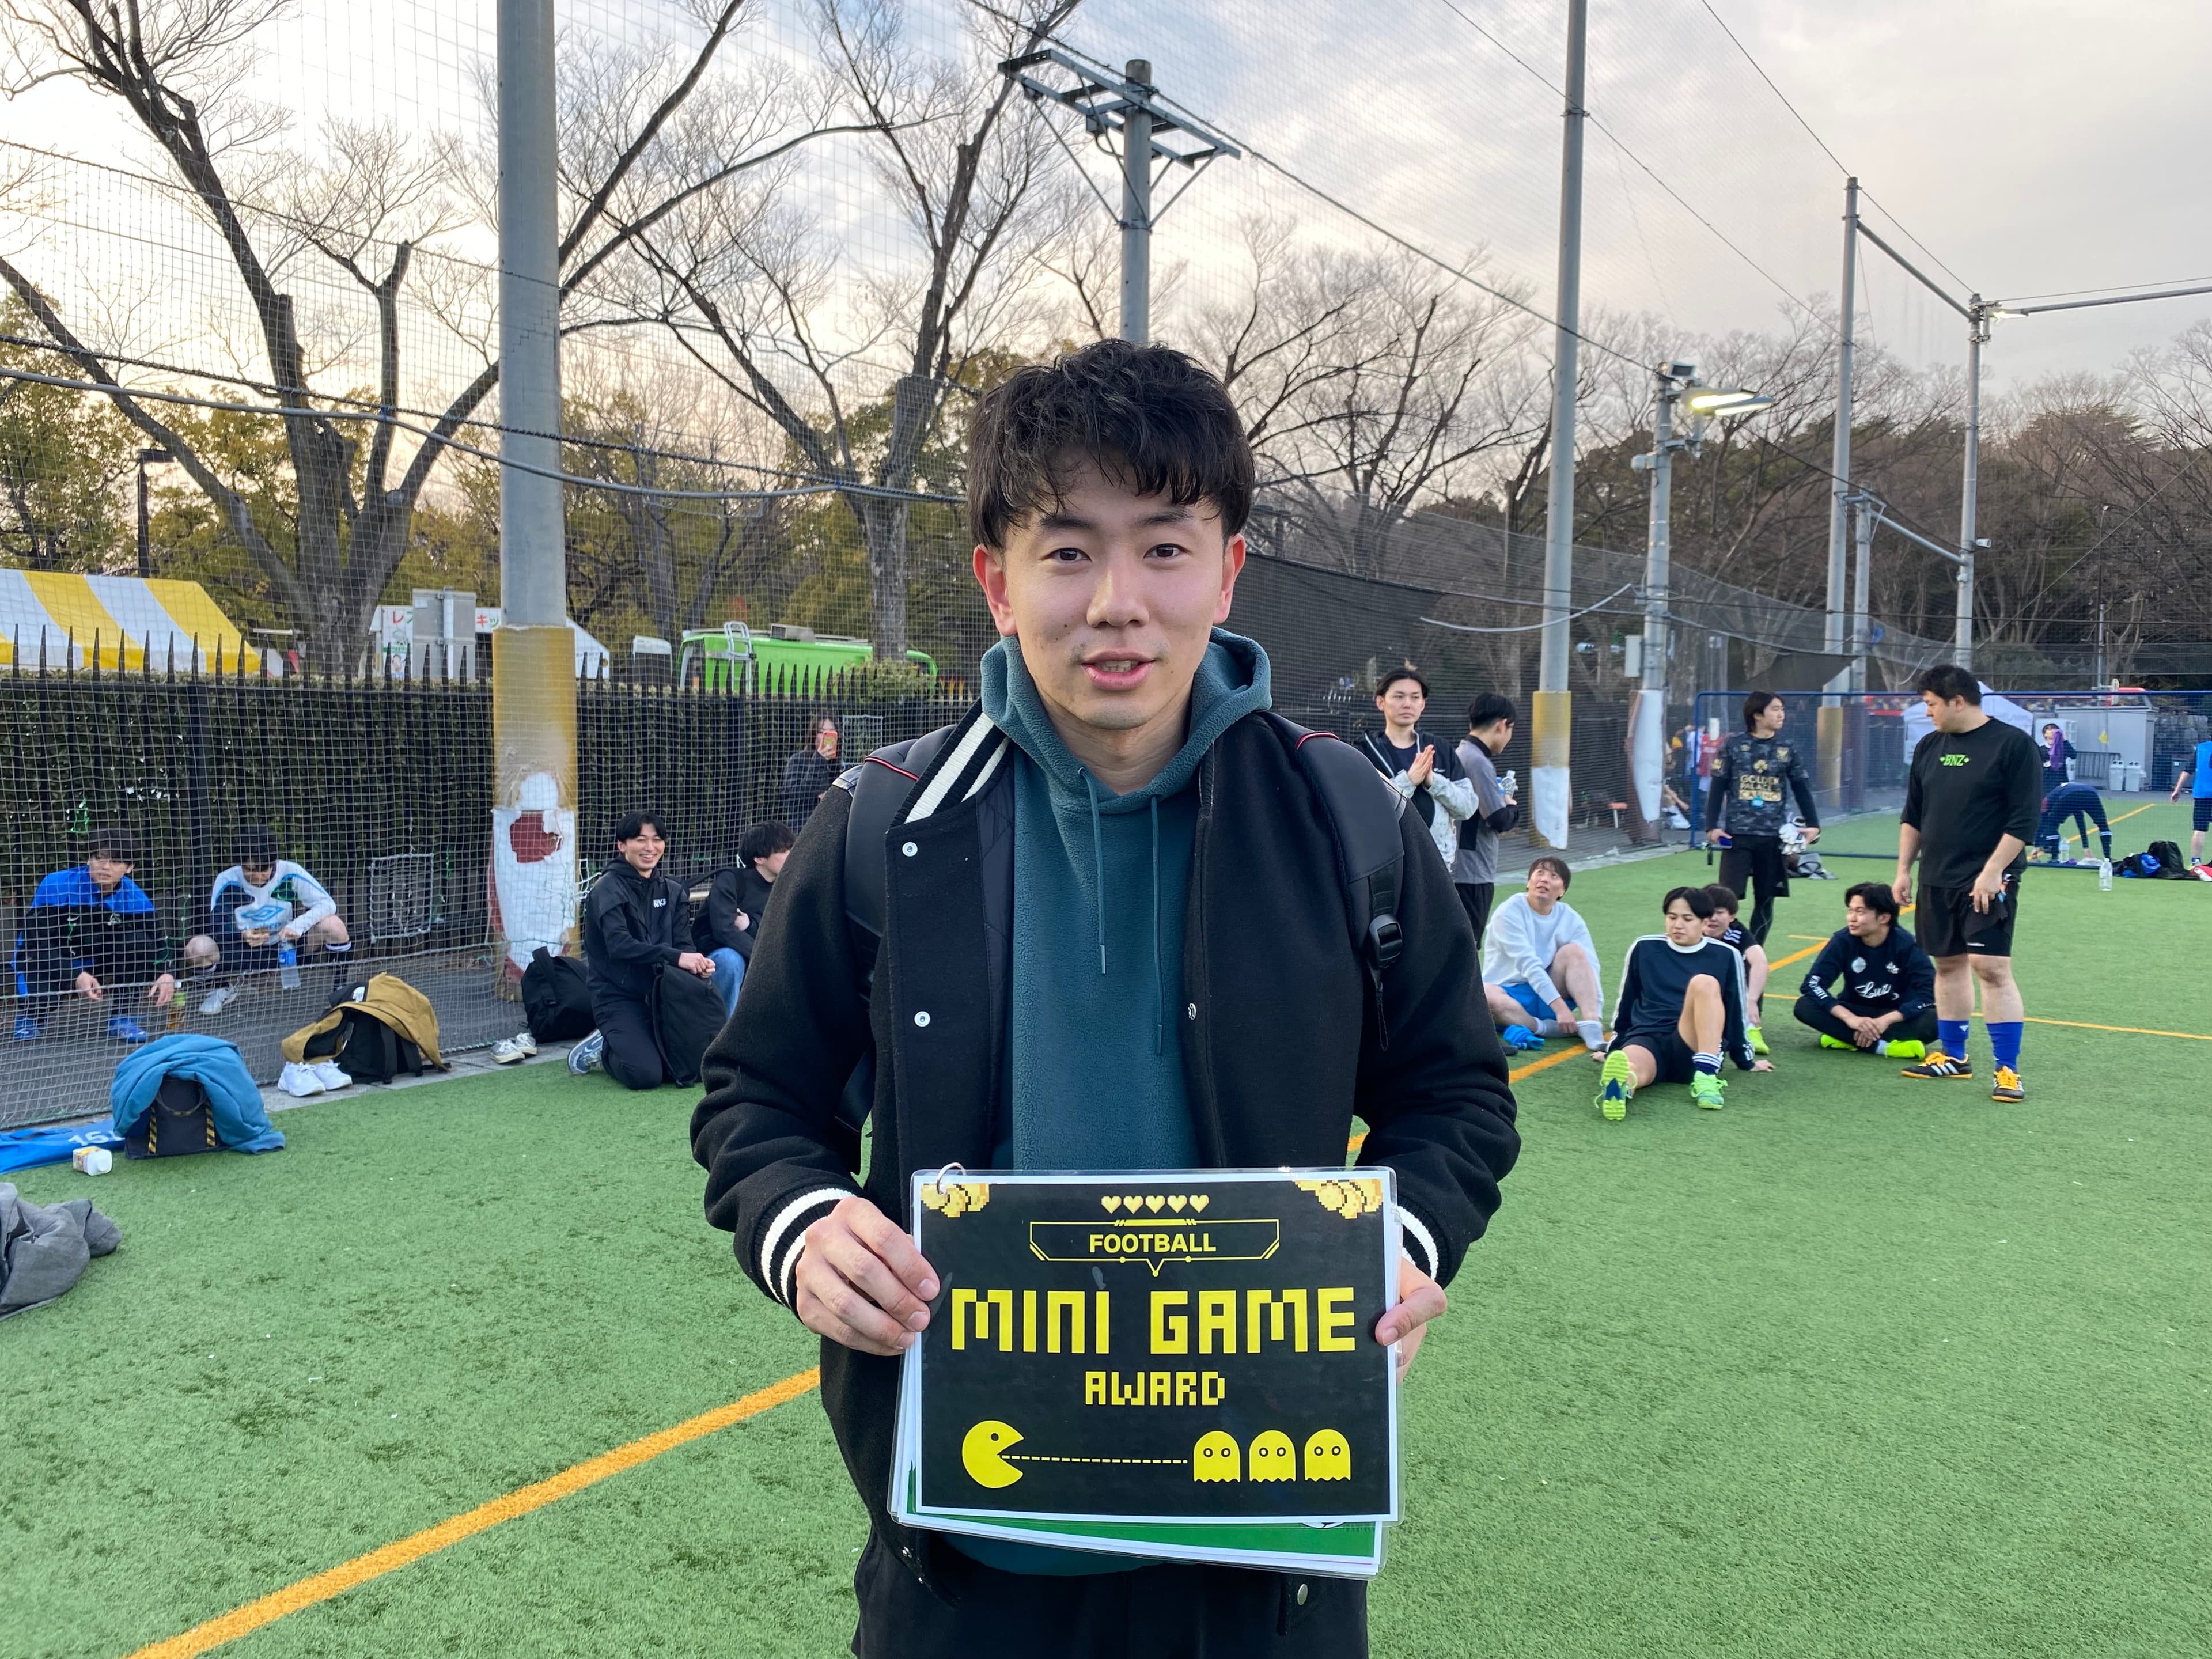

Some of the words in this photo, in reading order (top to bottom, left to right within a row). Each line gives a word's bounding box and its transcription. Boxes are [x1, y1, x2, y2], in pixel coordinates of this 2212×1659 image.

[1089, 1233, 1217, 1253] FOOTBALL
[952, 1289, 1109, 1354] MINI
[1150, 1287, 1355, 1354] GAME
[1085, 1371, 1225, 1406] AWARD
